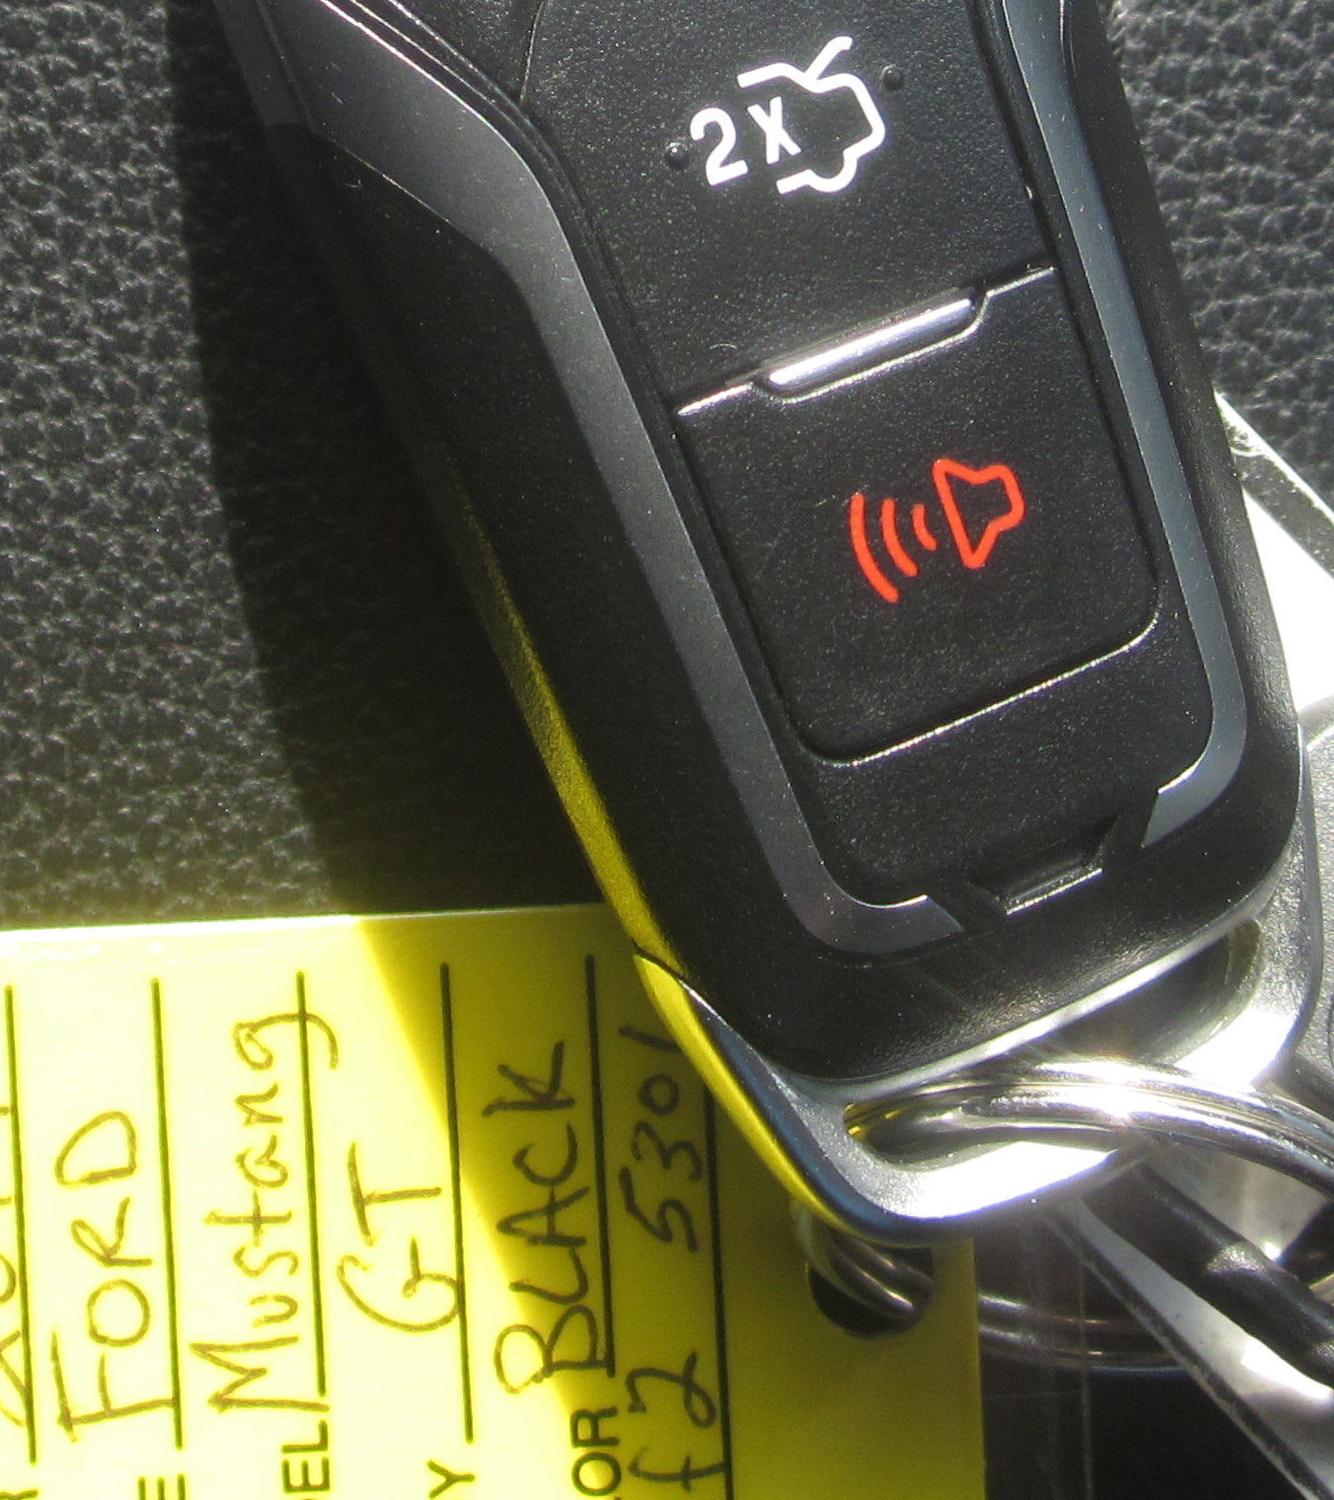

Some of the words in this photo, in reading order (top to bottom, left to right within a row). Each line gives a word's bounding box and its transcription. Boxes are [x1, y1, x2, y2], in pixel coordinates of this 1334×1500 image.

[190, 1012, 338, 1412] Mustang
[336, 1141, 461, 1332] GT
[483, 1040, 614, 1394] BLACK
[618, 1024, 703, 1254] 5301
[48, 1111, 179, 1441] FORD
[281, 1419, 331, 1500] EL
[570, 1406, 623, 1500] OR
